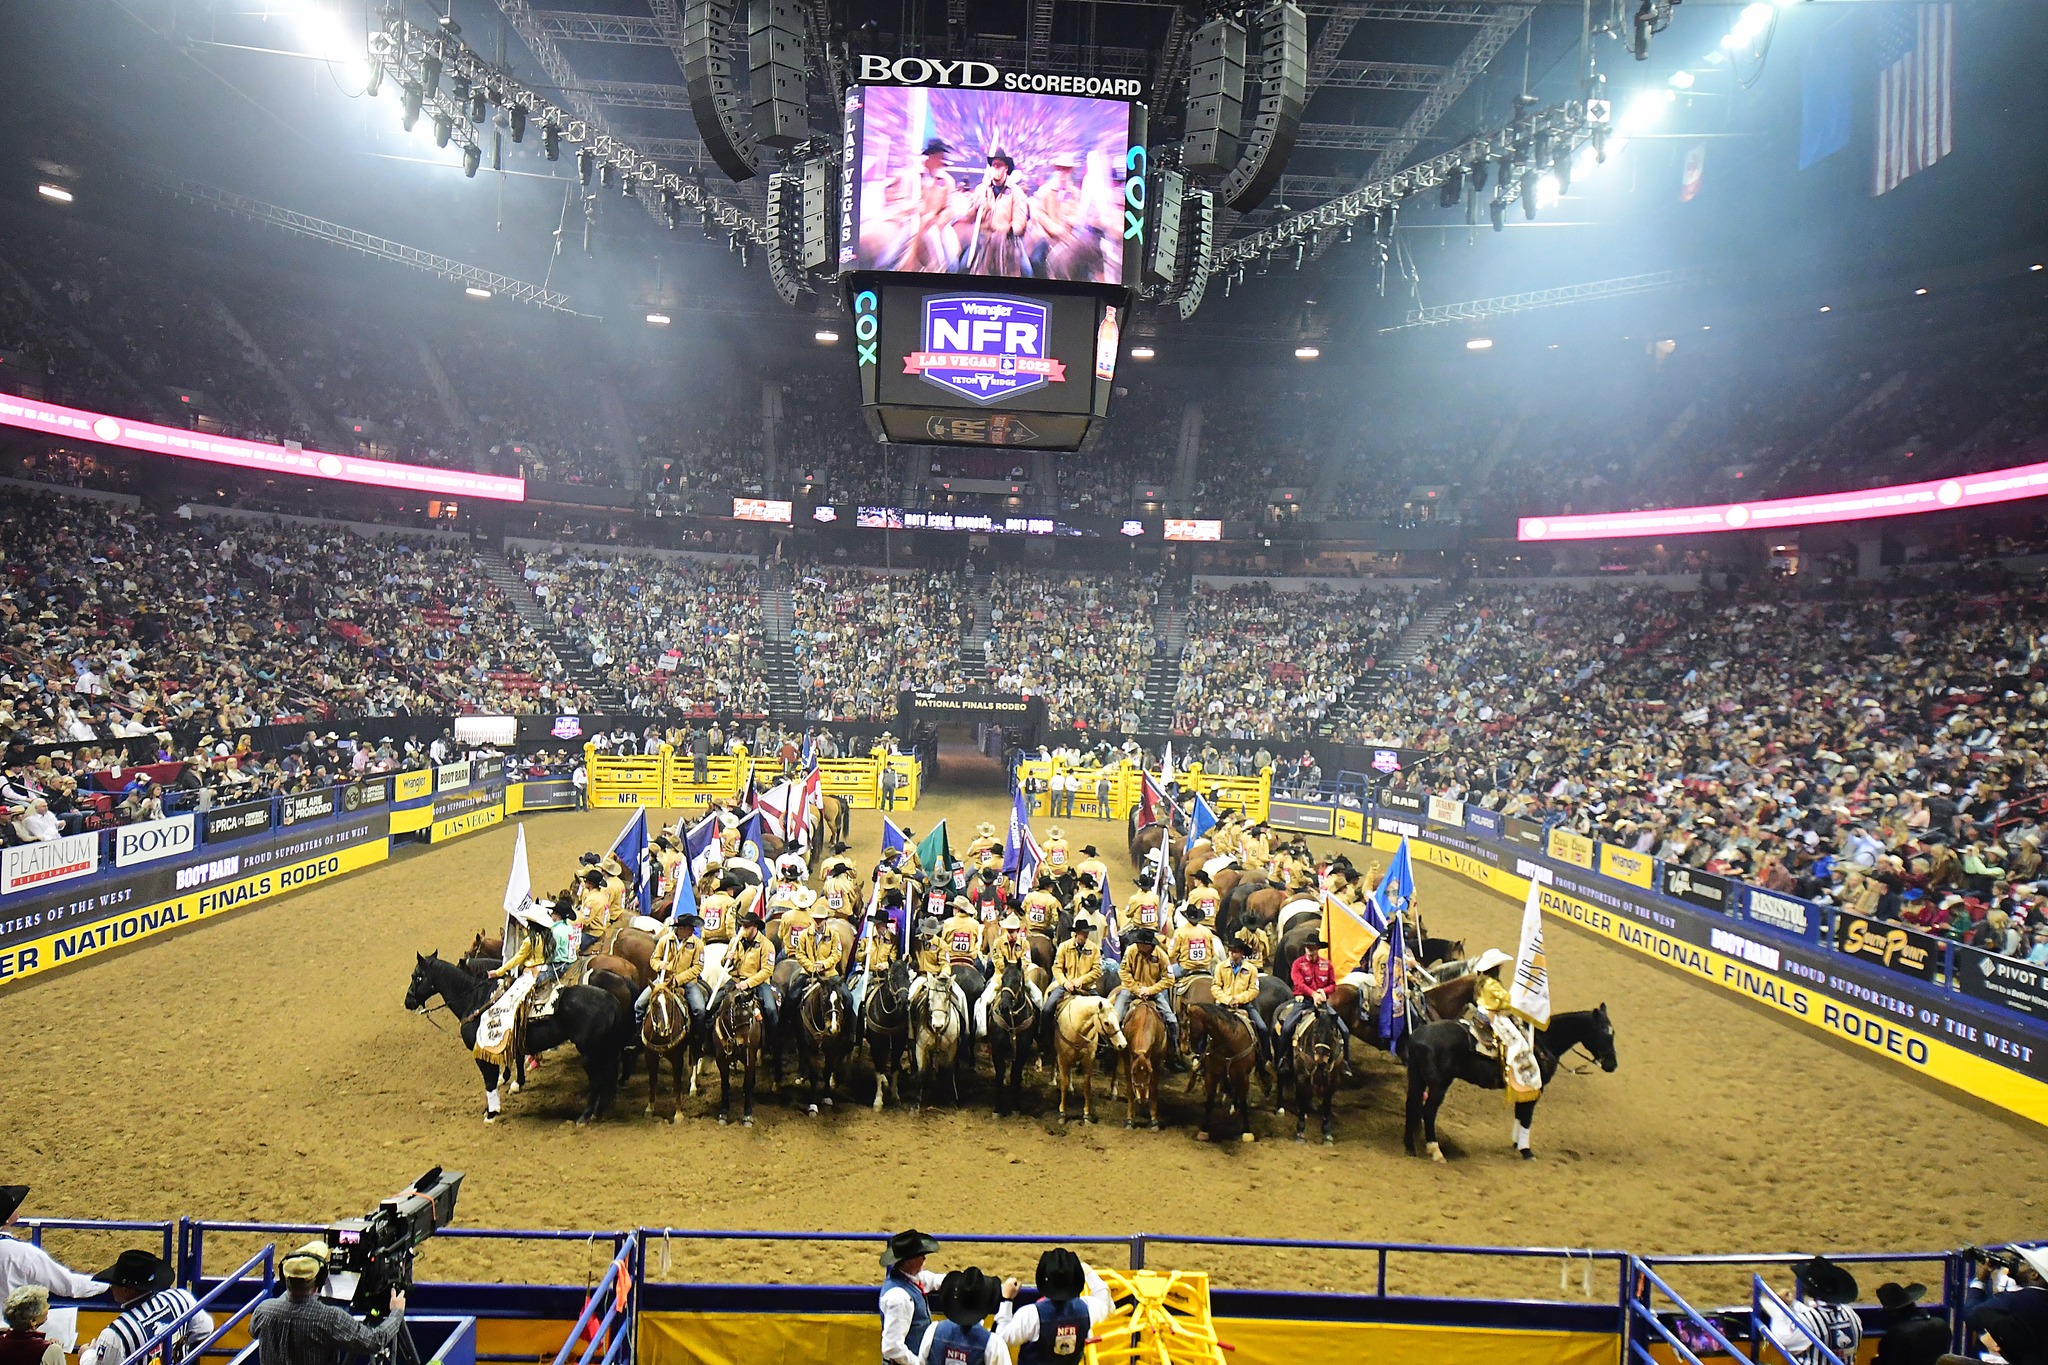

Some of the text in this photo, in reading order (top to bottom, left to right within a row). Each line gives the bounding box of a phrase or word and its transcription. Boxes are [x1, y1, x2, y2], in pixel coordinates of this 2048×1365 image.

[858, 54, 1141, 96] BOYD SCOREBOARD
[842, 119, 856, 242] LAS VEGAS
[1124, 145, 1146, 245] COX
[962, 302, 1013, 320] Wrangler
[855, 290, 878, 367] COX
[932, 318, 1038, 354] NFR
[919, 356, 997, 368] LAS VEGAS
[1018, 360, 1050, 372] 2022
[952, 376, 977, 384] TETON
[37, 411, 57, 424] ALL
[915, 692, 936, 700] Wrangler
[915, 700, 1027, 711] NATIONAL FINALS RODEO
[403, 776, 426, 793] Wrangler
[440, 772, 454, 785] BOOT
[454, 768, 468, 782] BARN
[295, 795, 323, 809] WE ARE
[618, 793, 638, 803] NFR
[694, 794, 712, 803] NFR
[1392, 796, 1419, 808] RAM
[295, 802, 332, 820] PRORODEO
[1080, 804, 1097, 813] NFR
[216, 816, 244, 834] PRCA ON
[444, 809, 496, 836] LAS VEGAS
[1470, 814, 1495, 829] POLARIS
[122, 825, 190, 856] BOYD
[1422, 830, 1438, 841] PROUD
[244, 826, 369, 868] PROUD SUPPORTERS OF THE WEST
[10, 838, 91, 877] PLATINUM
[1429, 847, 1489, 880] LAS VEGAS
[1611, 851, 1642, 876] Wrangler
[11, 862, 90, 886] PERFORMANCE
[176, 855, 240, 890] BOOT BARN
[47, 906, 64, 922] OF
[70, 898, 94, 916] THE
[100, 888, 132, 906] WEST
[54, 903, 189, 961] NATIONAL
[200, 877, 271, 914] FINALS
[281, 857, 338, 888] RODEO
[1555, 876, 1577, 892] PROUD
[1578, 884, 1621, 908] SUPPORTERS
[1622, 898, 1633, 911] OF
[1635, 904, 1650, 919] THE
[1653, 911, 1676, 929] WEST
[1751, 890, 1807, 928] RESISTOL
[706, 919, 717, 928] 57
[1146, 914, 1153, 922] 11
[956, 943, 967, 951] 40
[1192, 950, 1203, 958] 99
[1998, 964, 2038, 986] PIVOT
[1618, 923, 1714, 976] NATIONAL
[1724, 964, 1808, 1014] FINALS
[1824, 1003, 1928, 1064] RODEO
[1710, 928, 2034, 1063] BOOT BARN PROUD SUPPORTERS OF THE WEST
[2011, 988, 2032, 1001] Better
[142, 1308, 171, 1328] PRORODEO
[1057, 1326, 1077, 1336] NFR
[947, 1349, 967, 1361] NFR
